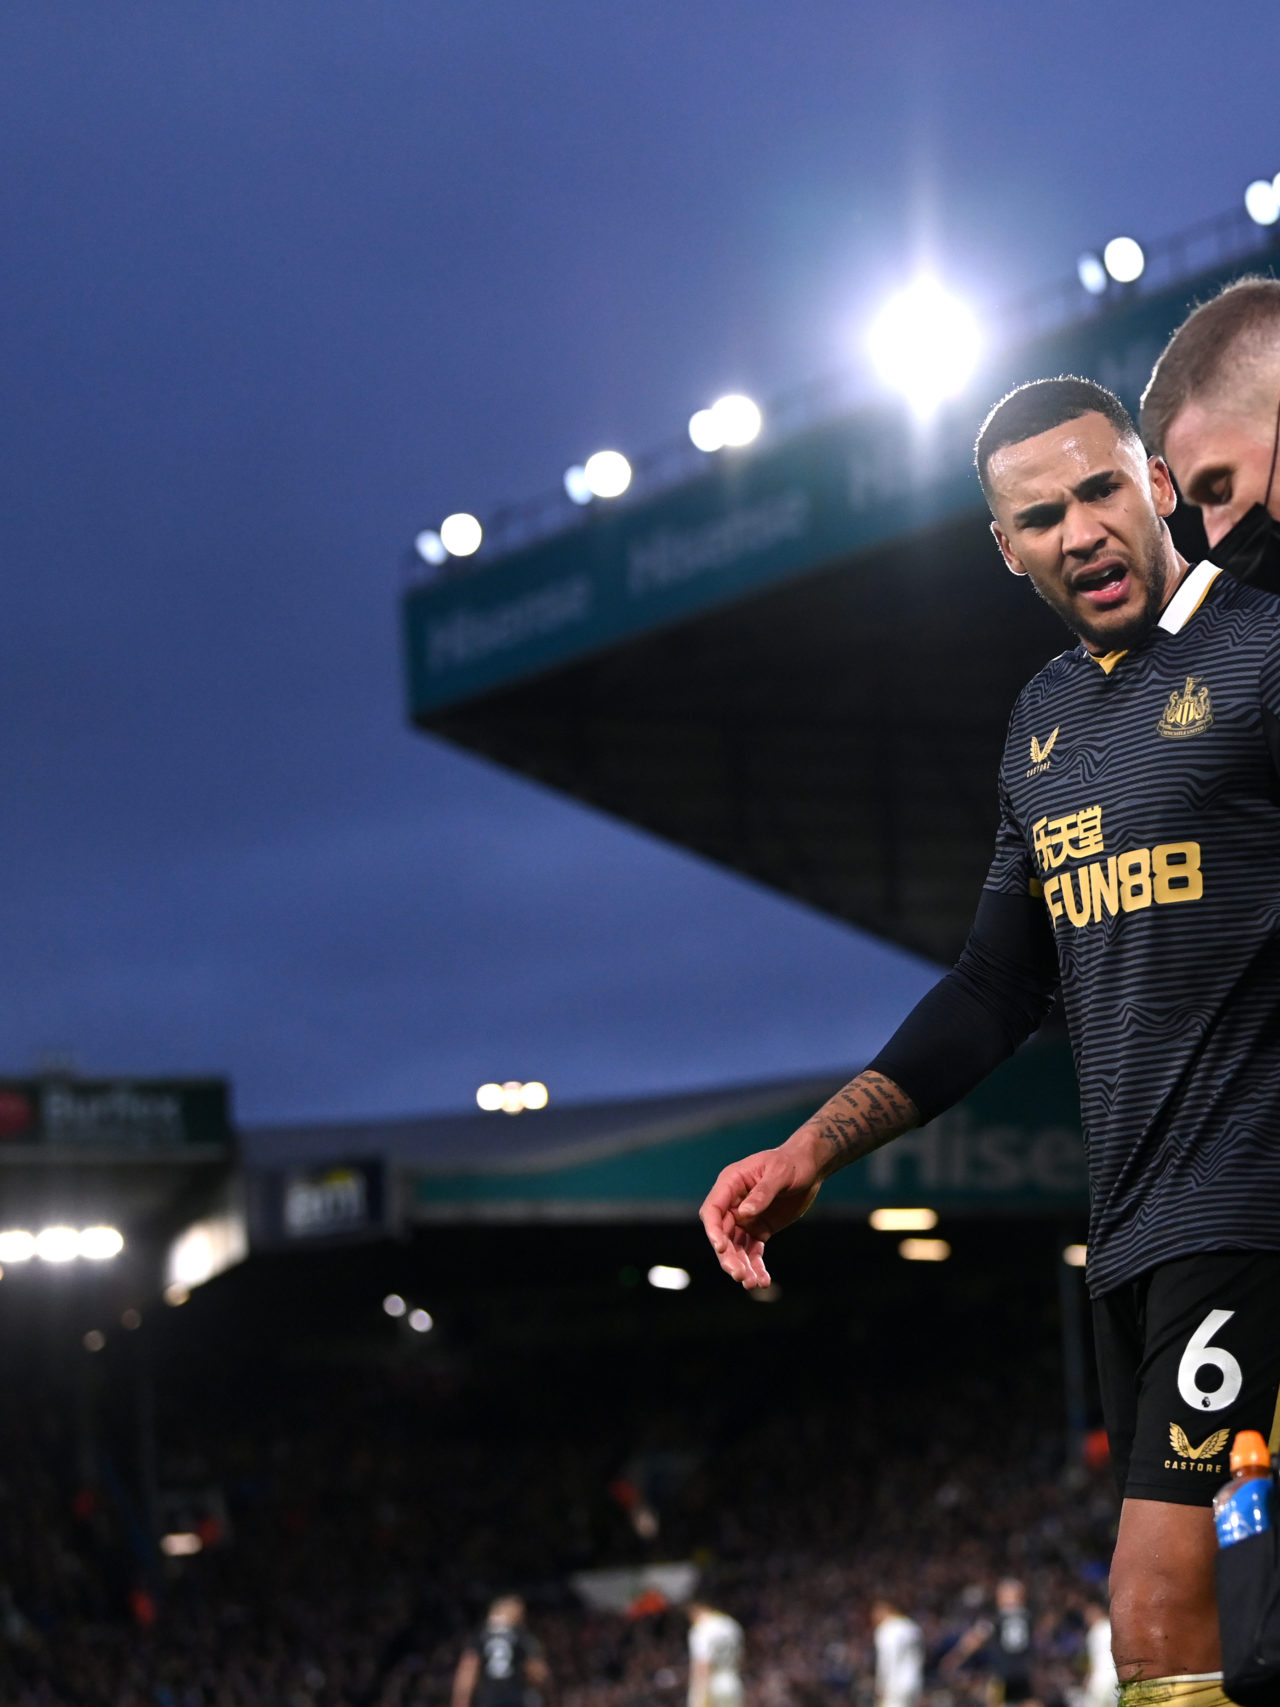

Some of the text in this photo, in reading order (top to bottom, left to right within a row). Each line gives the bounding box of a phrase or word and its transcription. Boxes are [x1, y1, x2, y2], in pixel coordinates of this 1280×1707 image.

[1043, 841, 1204, 933] FUN88
[868, 1108, 1090, 1191] Hise
[1177, 1309, 1243, 1411] 6
[1164, 1459, 1222, 1473] CASTORE
